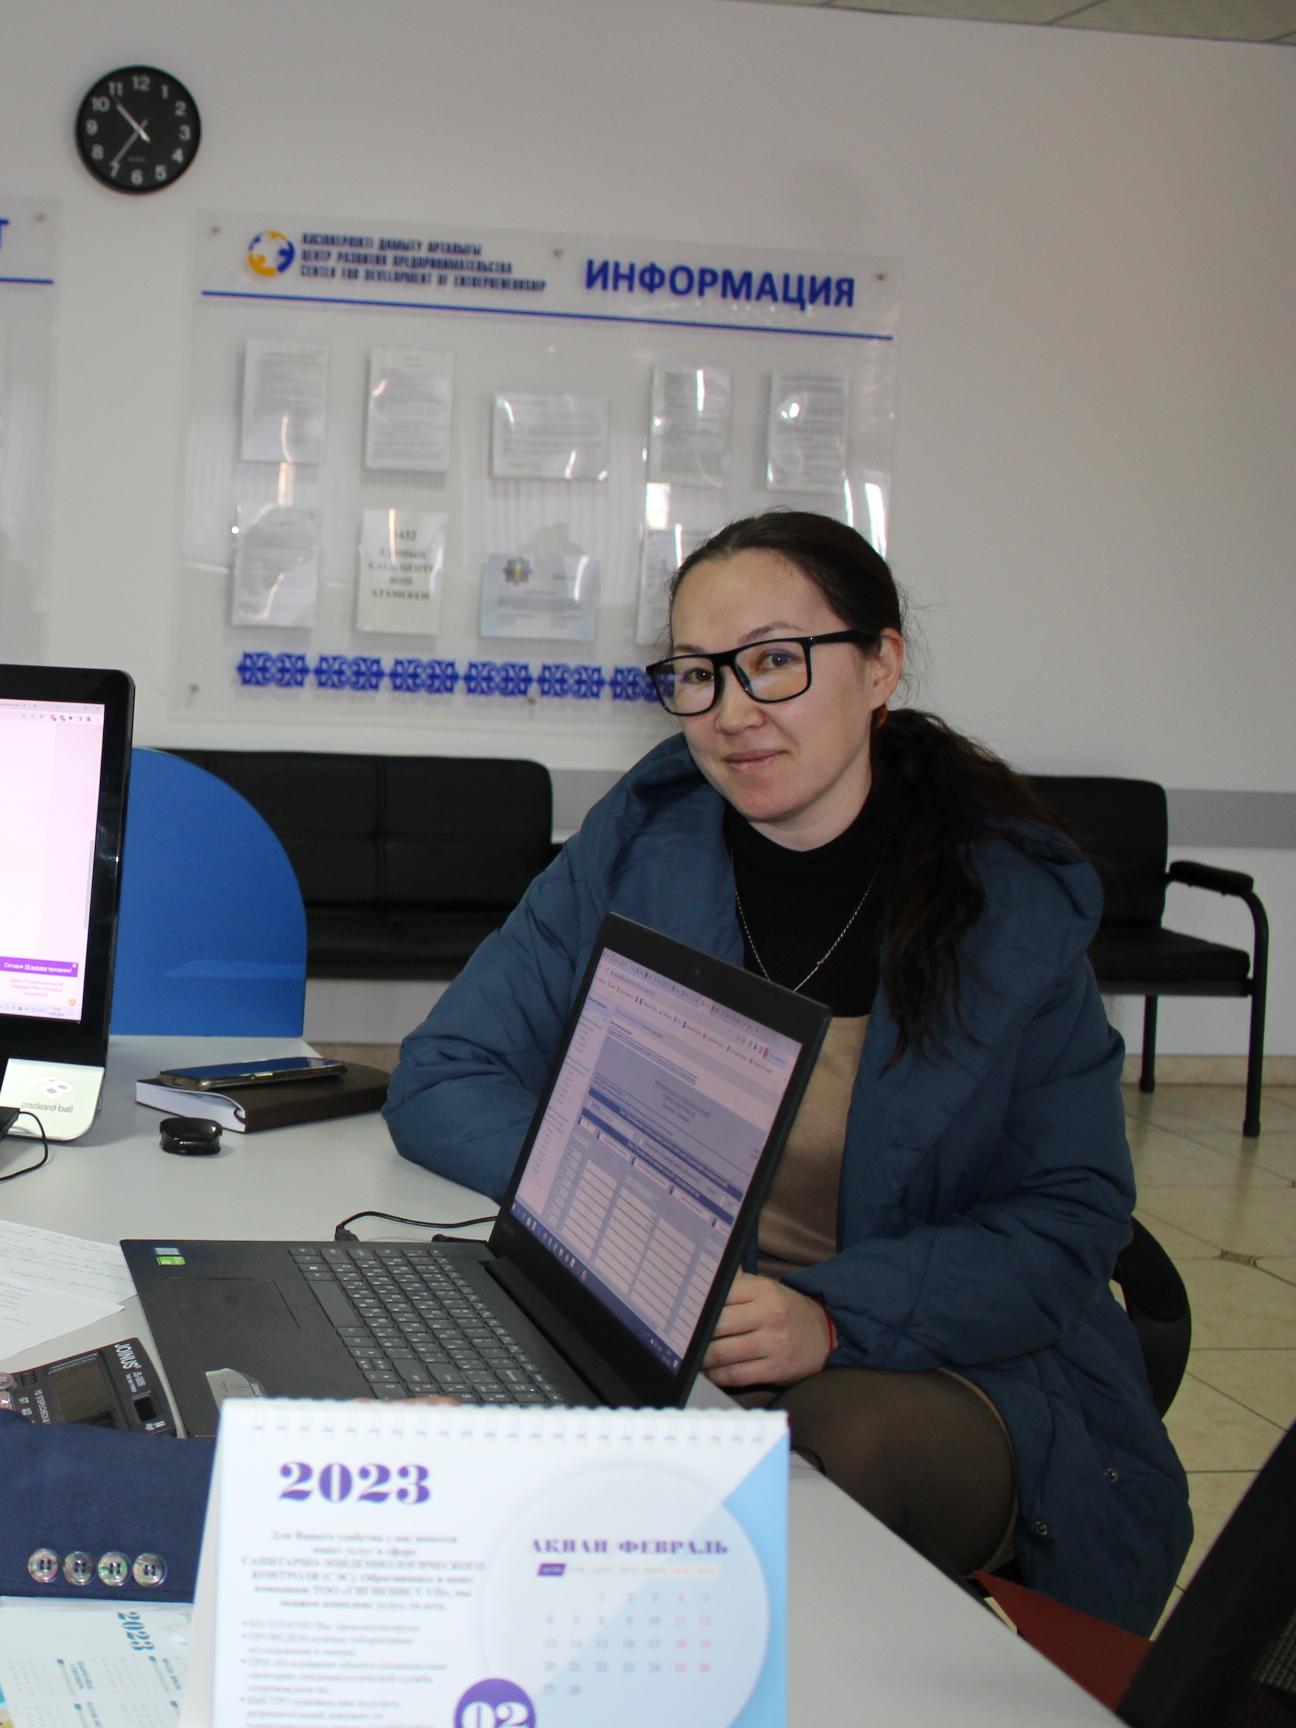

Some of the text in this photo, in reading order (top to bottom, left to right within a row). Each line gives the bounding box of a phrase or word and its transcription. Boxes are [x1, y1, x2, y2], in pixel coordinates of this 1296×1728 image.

[109, 82, 123, 97] 11
[133, 76, 150, 92] 12
[162, 85, 168, 99] 1
[93, 97, 110, 112] 10
[175, 101, 187, 117] 2
[86, 119, 98, 135] 9
[179, 125, 191, 141] 3
[92, 145, 103, 160] 8
[172, 149, 184, 164] 4
[131, 170, 143, 185] 6
[155, 165, 167, 181] 5
[586, 258, 855, 311] ИНФОРМАЦИЯ
[114, 1343, 139, 1369] JOINUS
[279, 1462, 431, 1505] 2023
[619, 1539, 729, 1554] ФЕВРАЛЬ
[116, 1611, 155, 1651] 2023
[462, 1700, 529, 1728] 02
